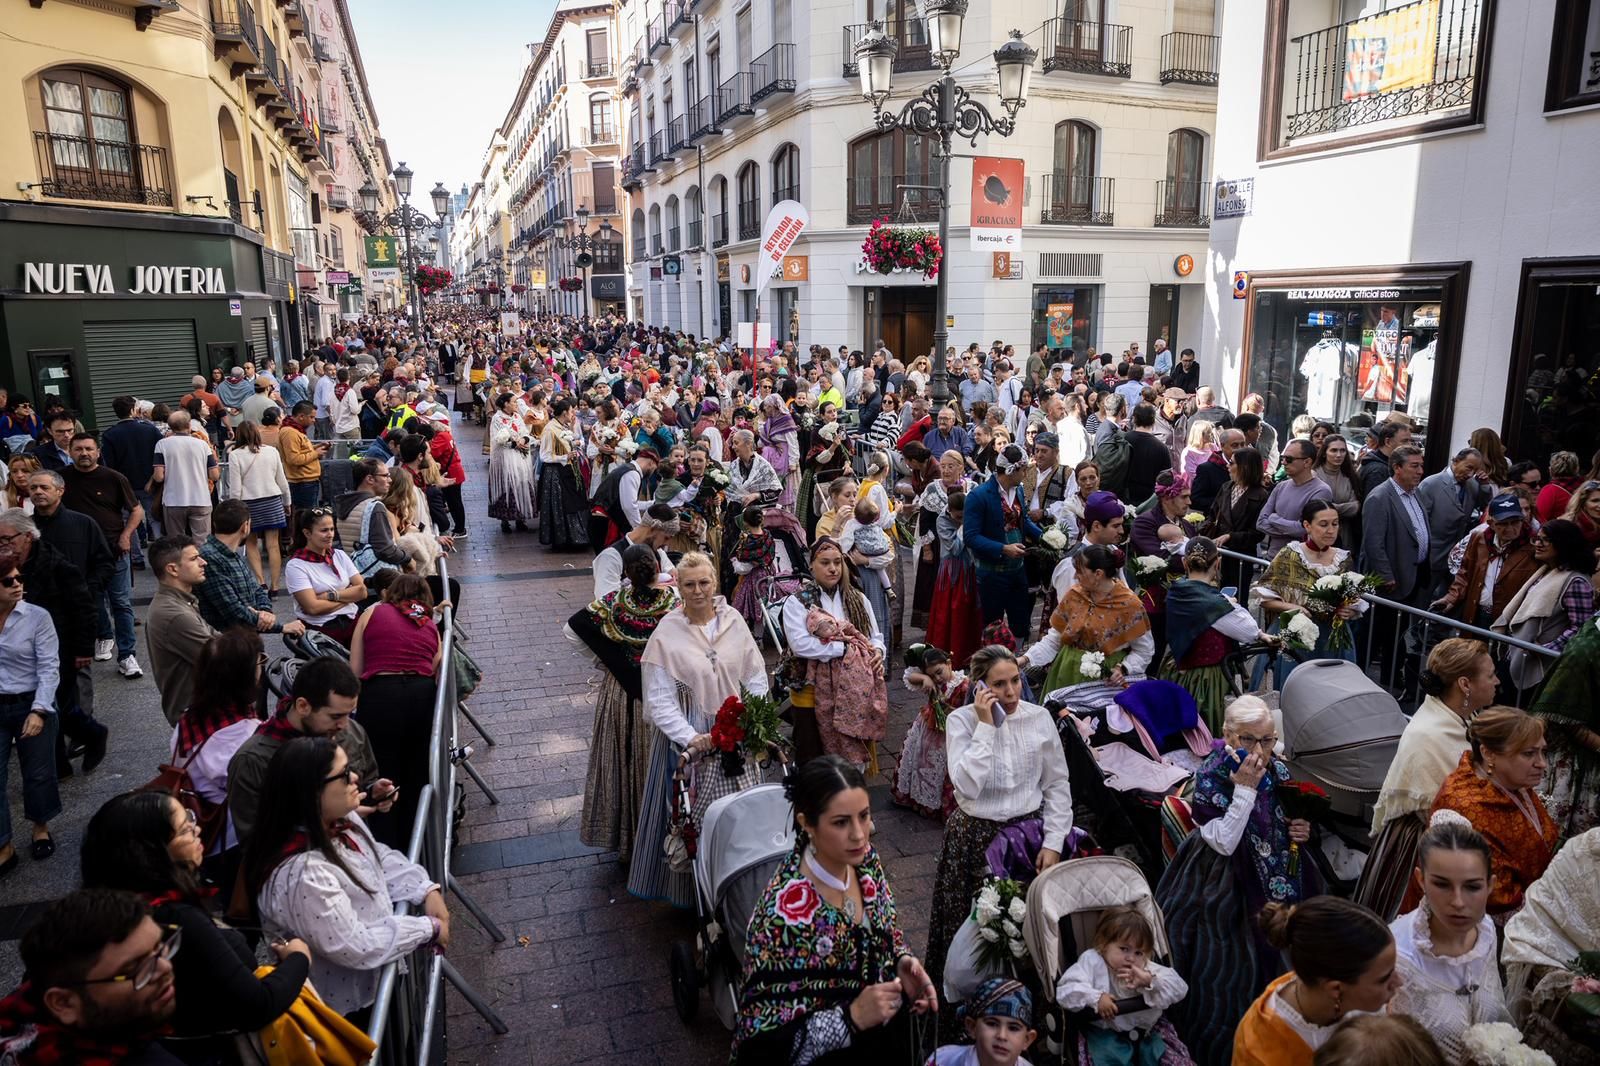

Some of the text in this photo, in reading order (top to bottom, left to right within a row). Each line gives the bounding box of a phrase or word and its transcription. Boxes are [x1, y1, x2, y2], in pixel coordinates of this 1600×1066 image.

[1229, 183, 1250, 194] CALLE
[1218, 199, 1246, 211] ALFONSO
[977, 216, 1016, 225] ¡GRACIAS!
[764, 216, 793, 252] RETIRADA
[977, 234, 1003, 243] Ibercaja
[771, 250, 783, 261] DE
[24, 262, 226, 294] NUEVA JOYERIA
[1288, 289, 1400, 300] REAL ZARAGOZA official store
[1363, 330, 1398, 339] ZARAGO
